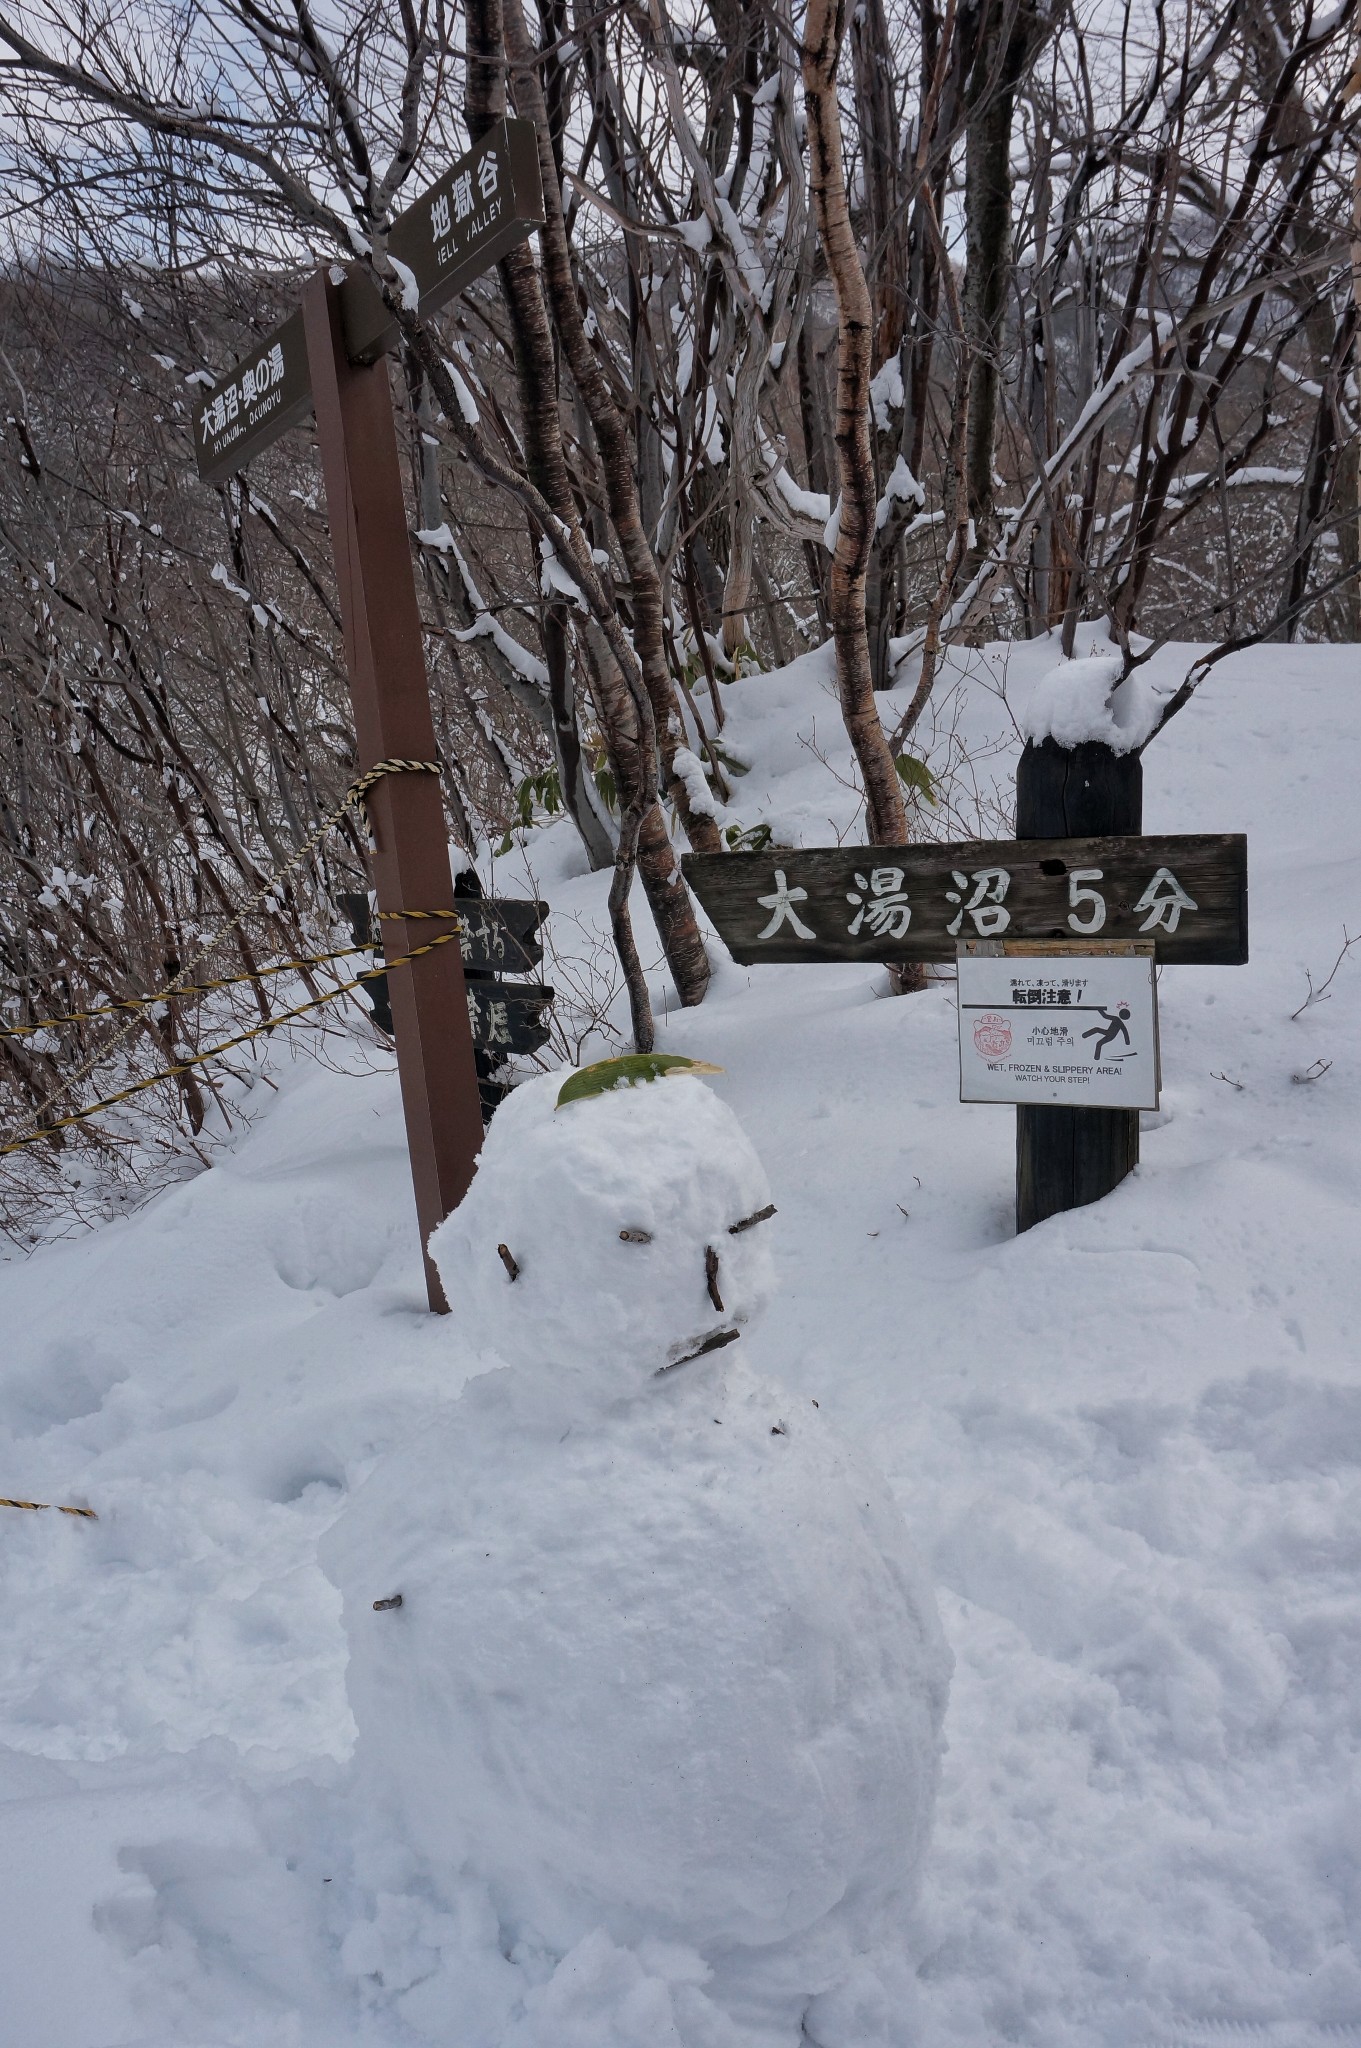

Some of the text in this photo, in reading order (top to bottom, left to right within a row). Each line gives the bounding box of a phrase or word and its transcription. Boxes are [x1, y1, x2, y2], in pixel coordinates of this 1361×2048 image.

[430, 150, 499, 243] 地獄谷
[756, 867, 1199, 940] 大湯沼 5分
[1031, 1026, 1069, 1036] 小心地滑
[1056, 1036, 1075, 1046] 주의
[987, 1063, 1122, 1075] WET, FROZEN & SLIPPERY AREA!
[1015, 1075, 1090, 1084] WATCH YOUR STEP!
